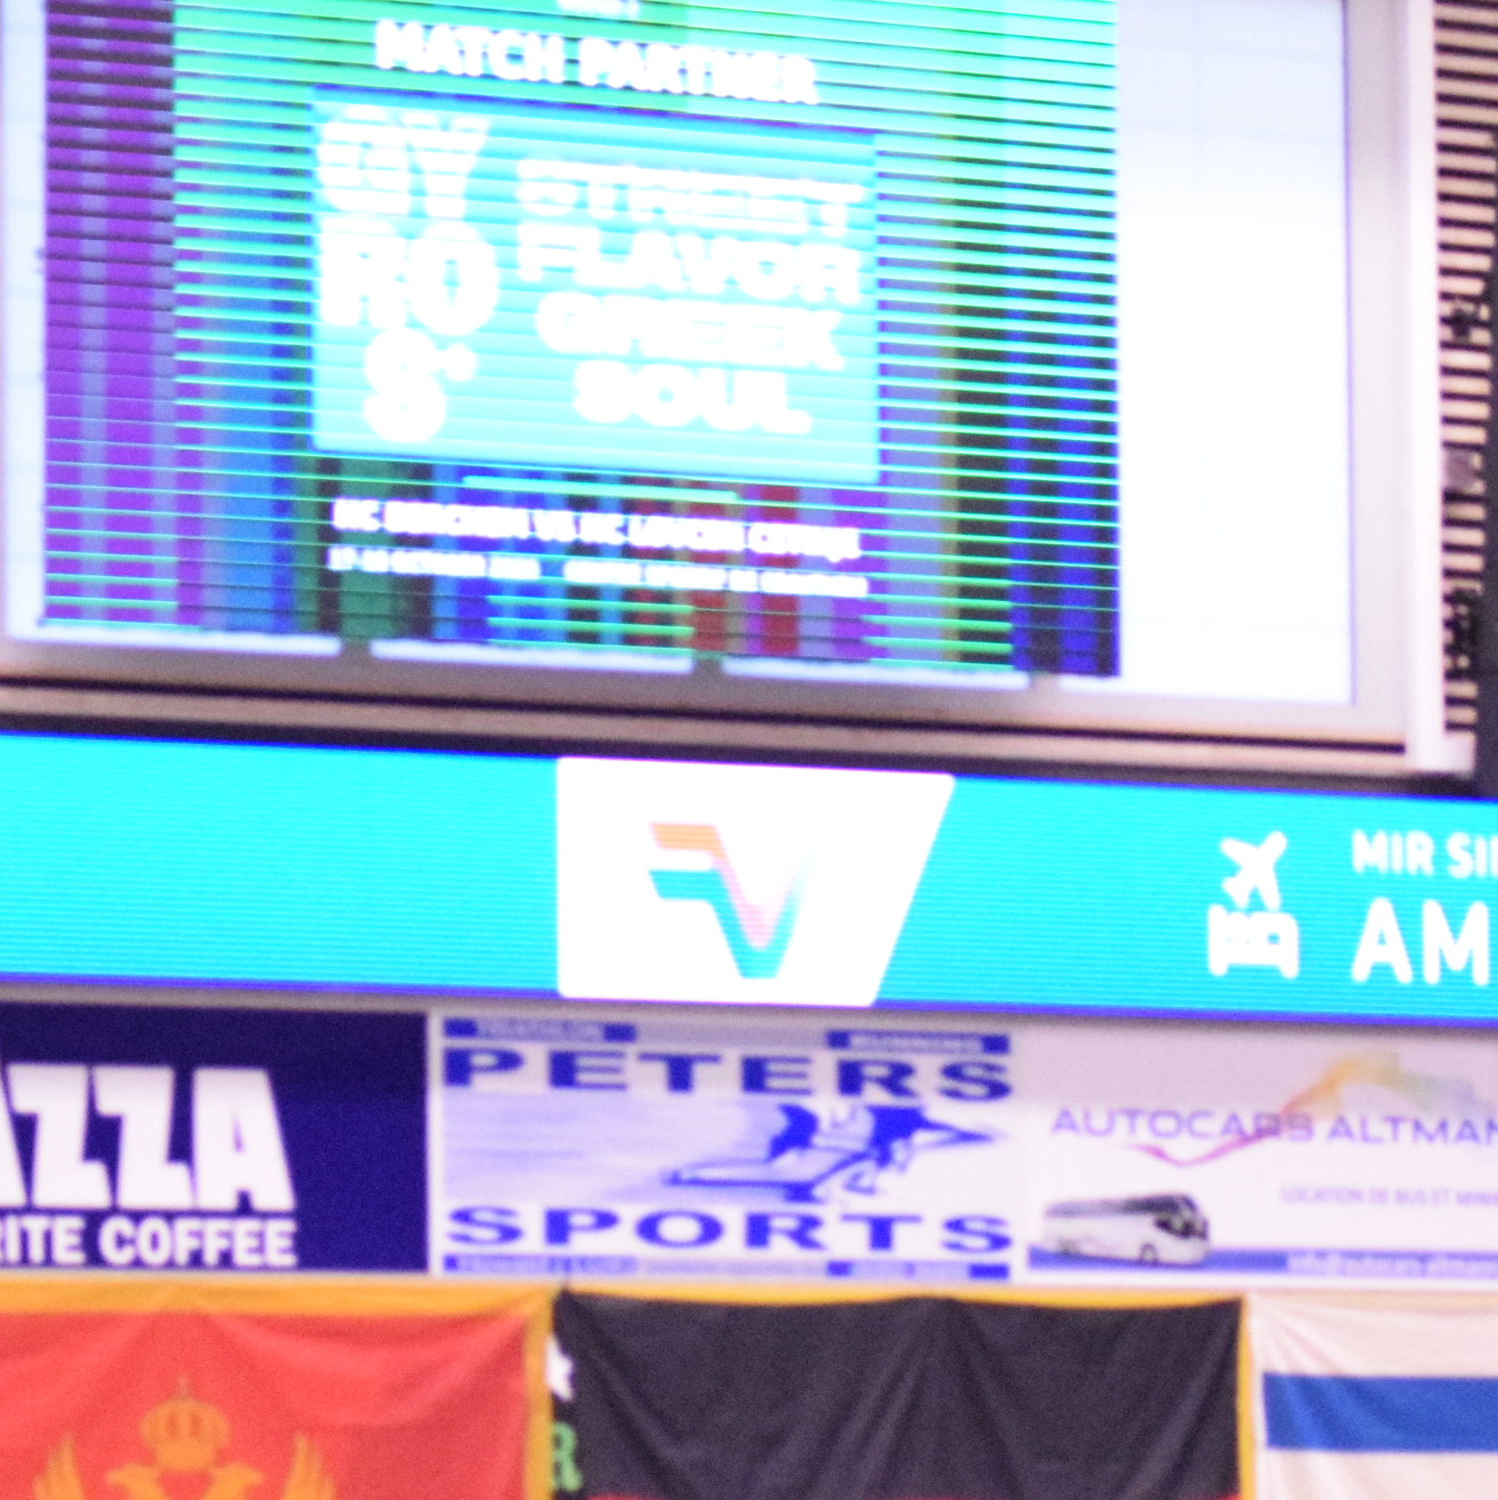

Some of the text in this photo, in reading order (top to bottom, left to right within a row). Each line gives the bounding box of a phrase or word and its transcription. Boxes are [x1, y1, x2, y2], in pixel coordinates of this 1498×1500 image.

[374, 19, 821, 105] MATCH PARTNER
[516, 159, 865, 238] STREET
[517, 220, 861, 305] FLAVOR
[535, 291, 845, 370] GREEK
[572, 360, 812, 435] SOUL
[1351, 828, 1435, 876] MIR
[1351, 897, 1490, 986] AM
[443, 1046, 1012, 1102] PETERS
[1050, 1106, 1314, 1142] AUTOCARS
[99, 1215, 298, 1268] COFFEE
[446, 1205, 1013, 1254] SPORTS
